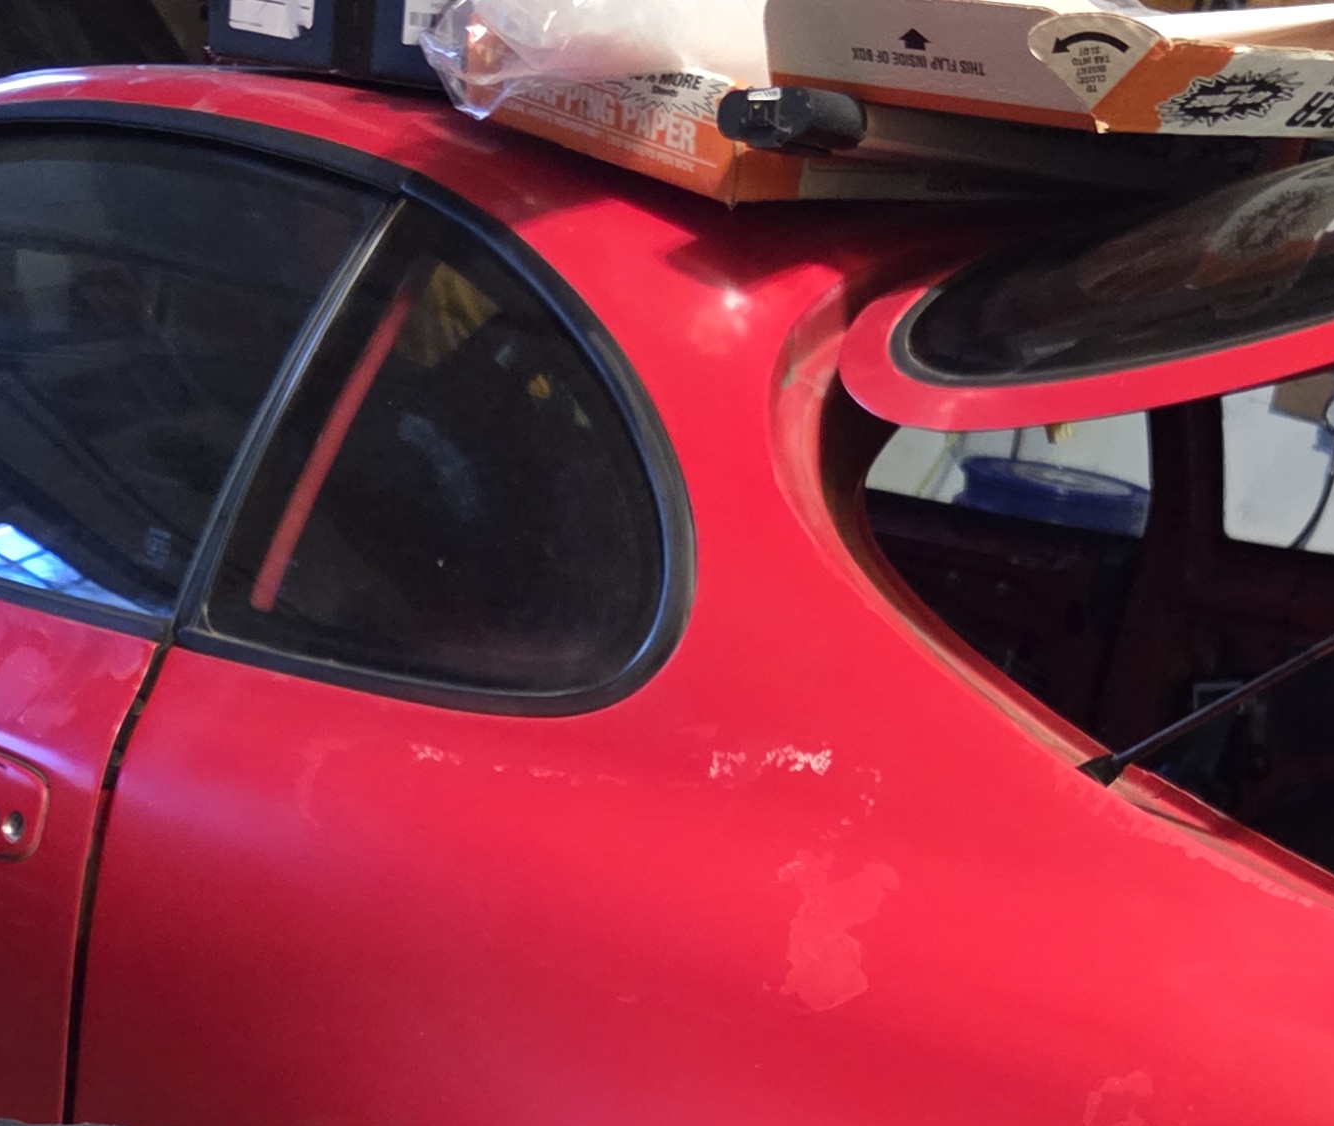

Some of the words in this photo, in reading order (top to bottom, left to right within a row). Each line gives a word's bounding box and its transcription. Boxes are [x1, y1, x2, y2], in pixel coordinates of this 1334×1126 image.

[851, 47, 874, 62] BOX
[875, 50, 890, 64] OF
[891, 52, 928, 69] INSIDE
[929, 56, 957, 73] FLAP
[958, 60, 986, 76] THIS
[658, 72, 704, 90] MORE
[621, 103, 696, 155] PAPER
